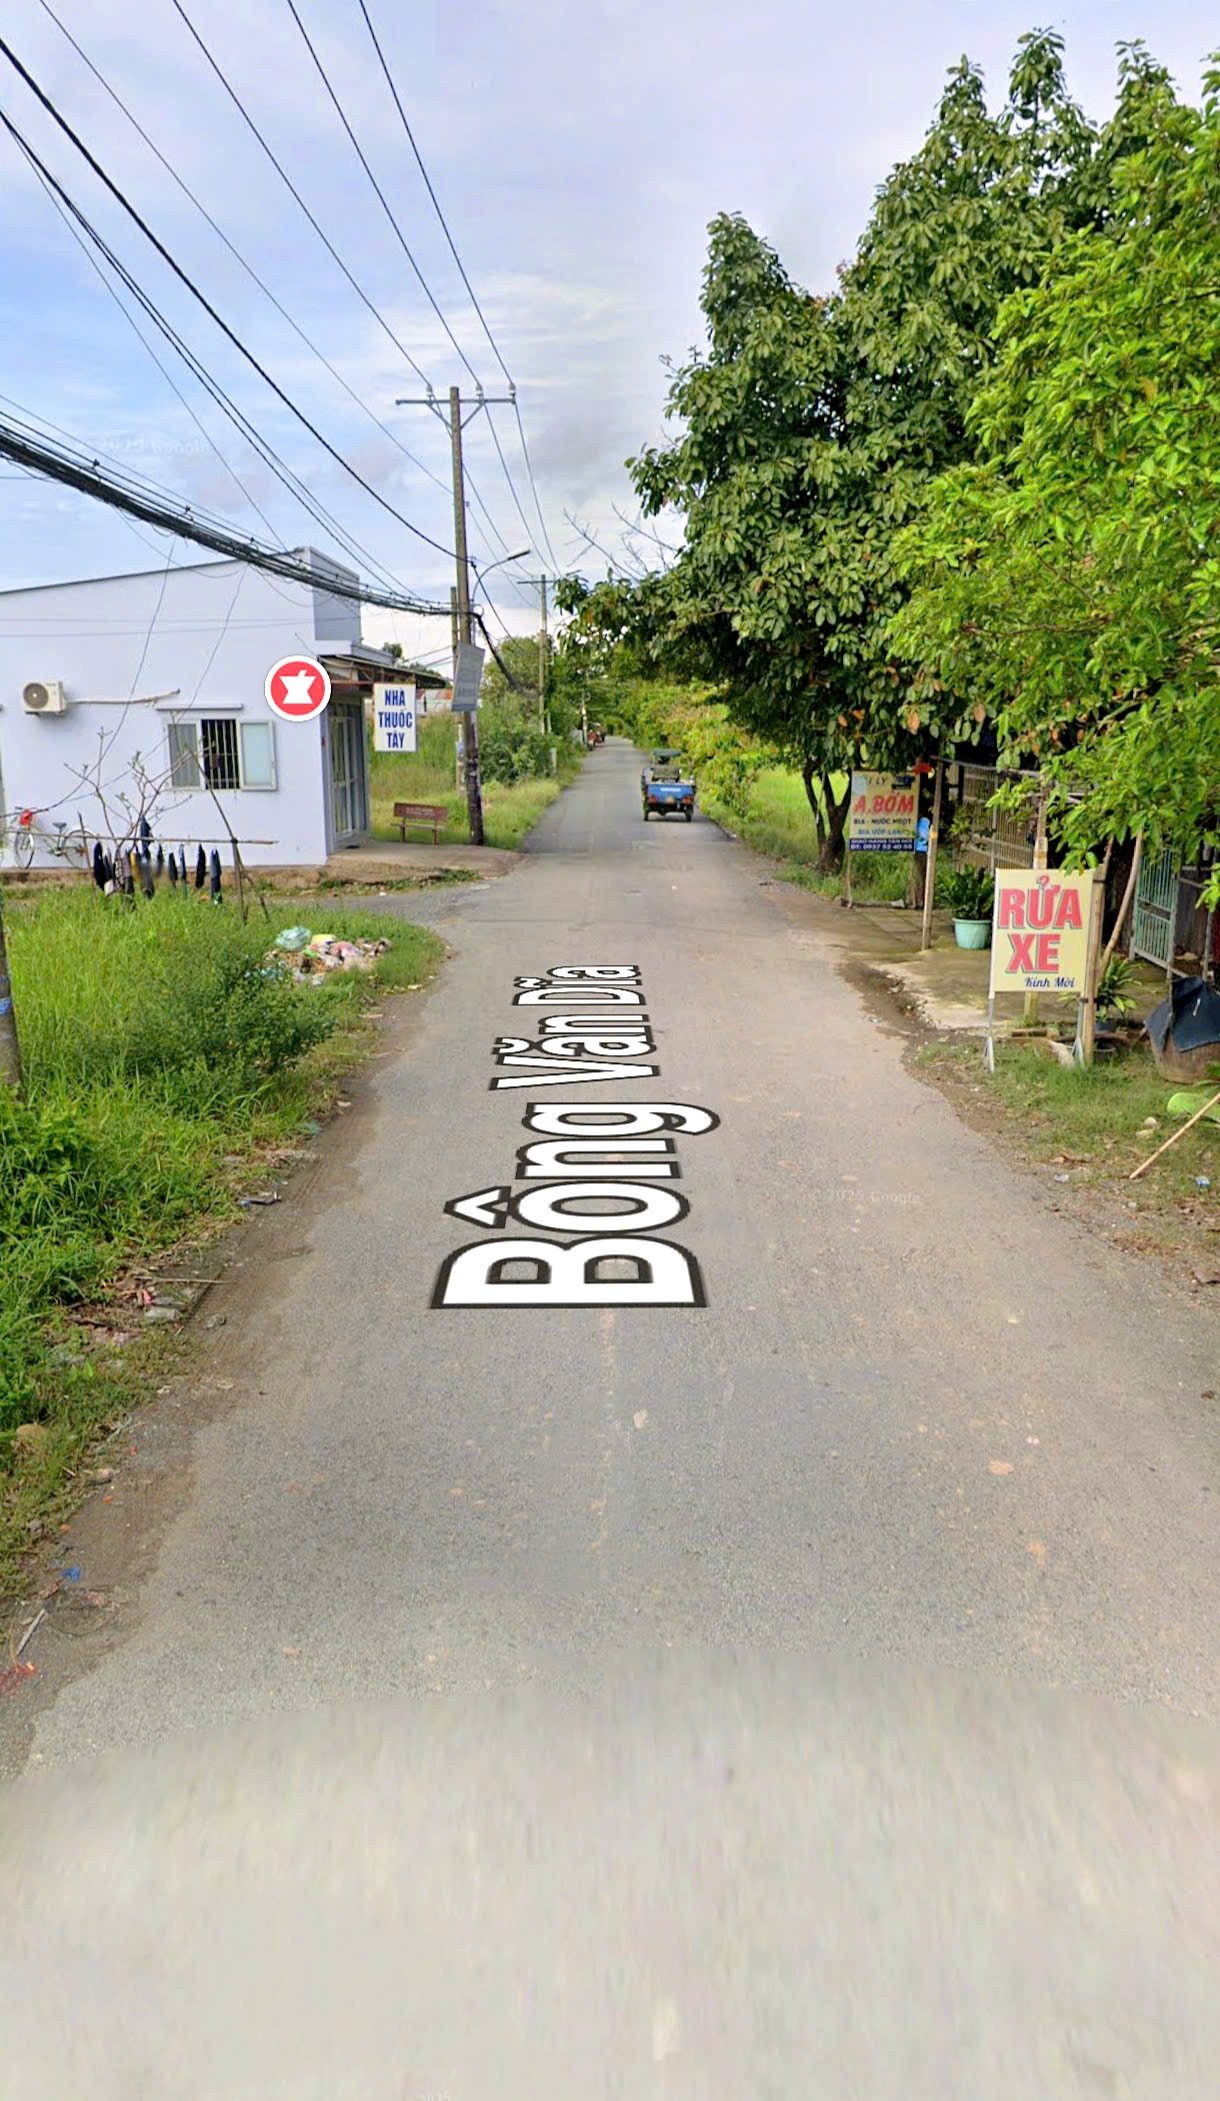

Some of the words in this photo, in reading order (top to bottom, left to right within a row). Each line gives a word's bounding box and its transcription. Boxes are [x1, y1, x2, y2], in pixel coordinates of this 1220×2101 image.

[385, 687, 405, 706] NHÀ
[378, 708, 413, 728] THUỐC
[387, 730, 405, 748] TÂY
[998, 876, 1082, 929] RỬA
[1005, 934, 1061, 974] XE
